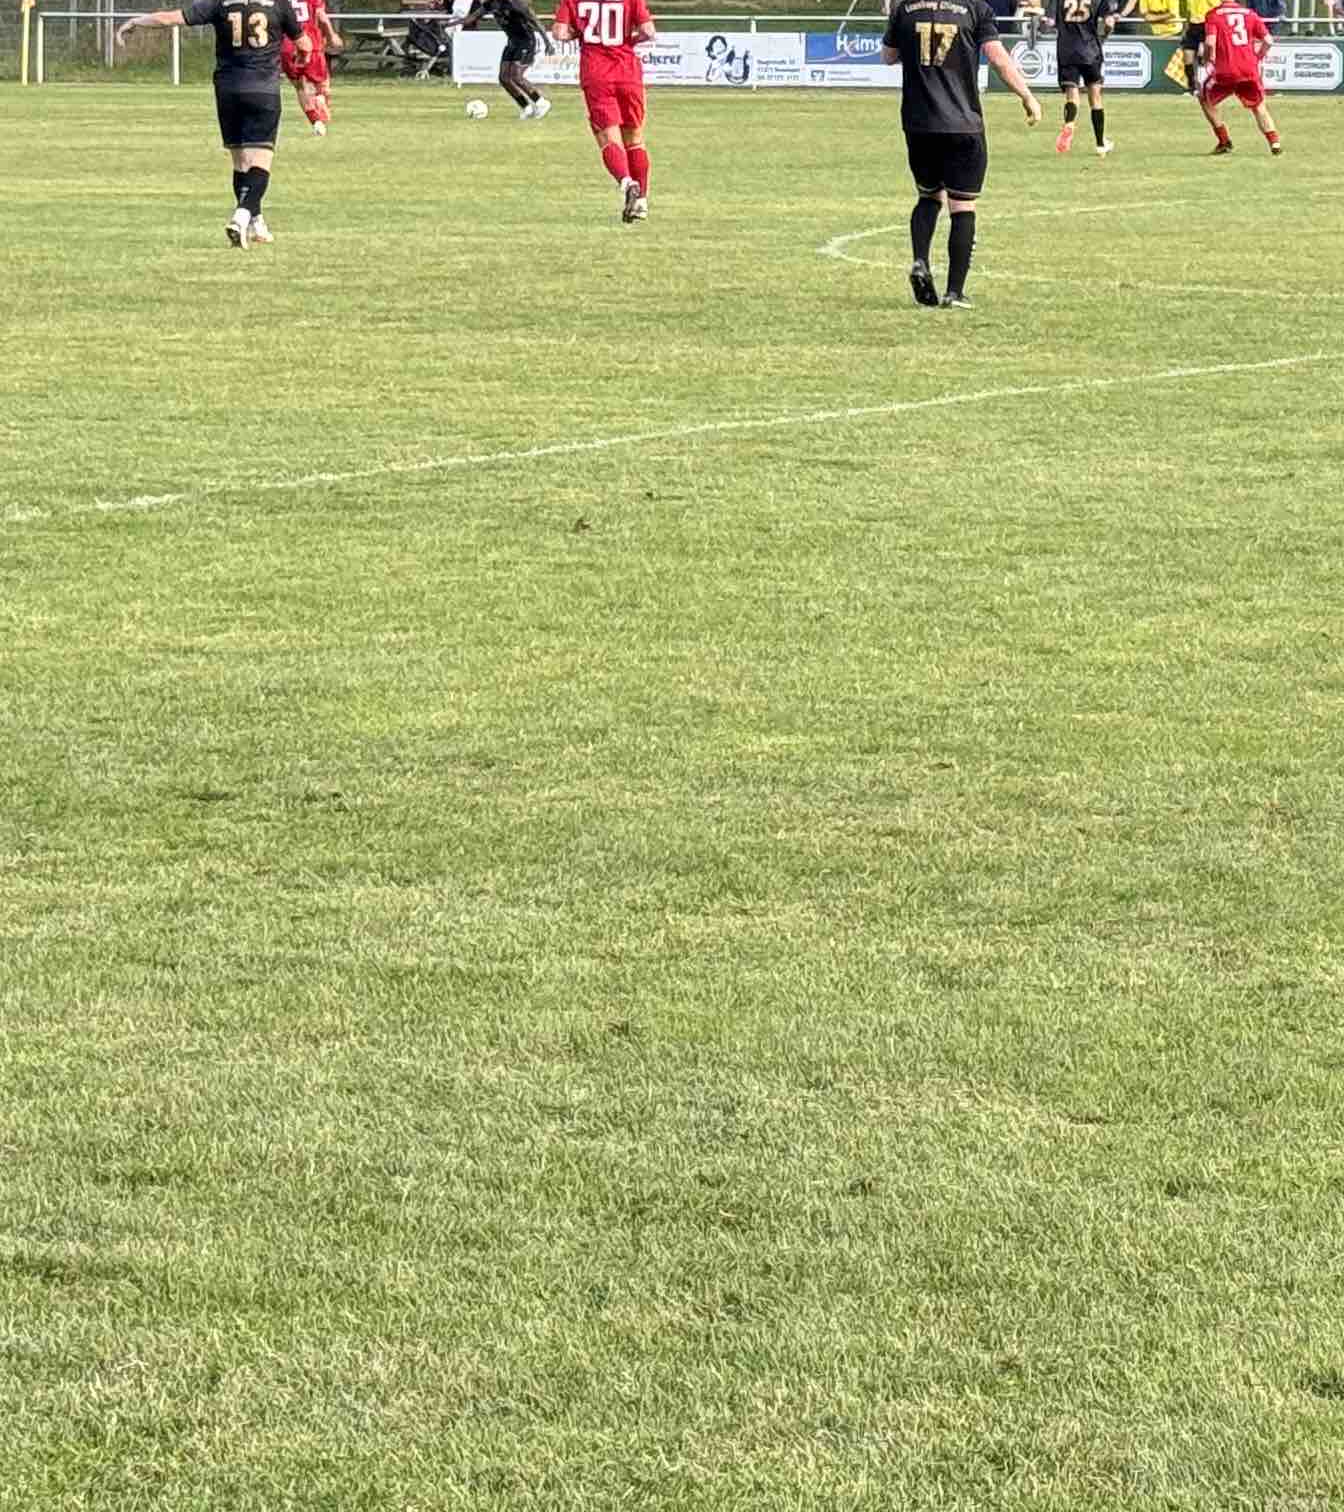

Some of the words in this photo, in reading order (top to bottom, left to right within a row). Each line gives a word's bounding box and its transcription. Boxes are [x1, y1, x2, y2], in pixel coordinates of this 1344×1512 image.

[227, 11, 269, 48] 13
[577, 1, 624, 46] 20
[915, 21, 958, 66] 17
[1227, 14, 1249, 46] 3
